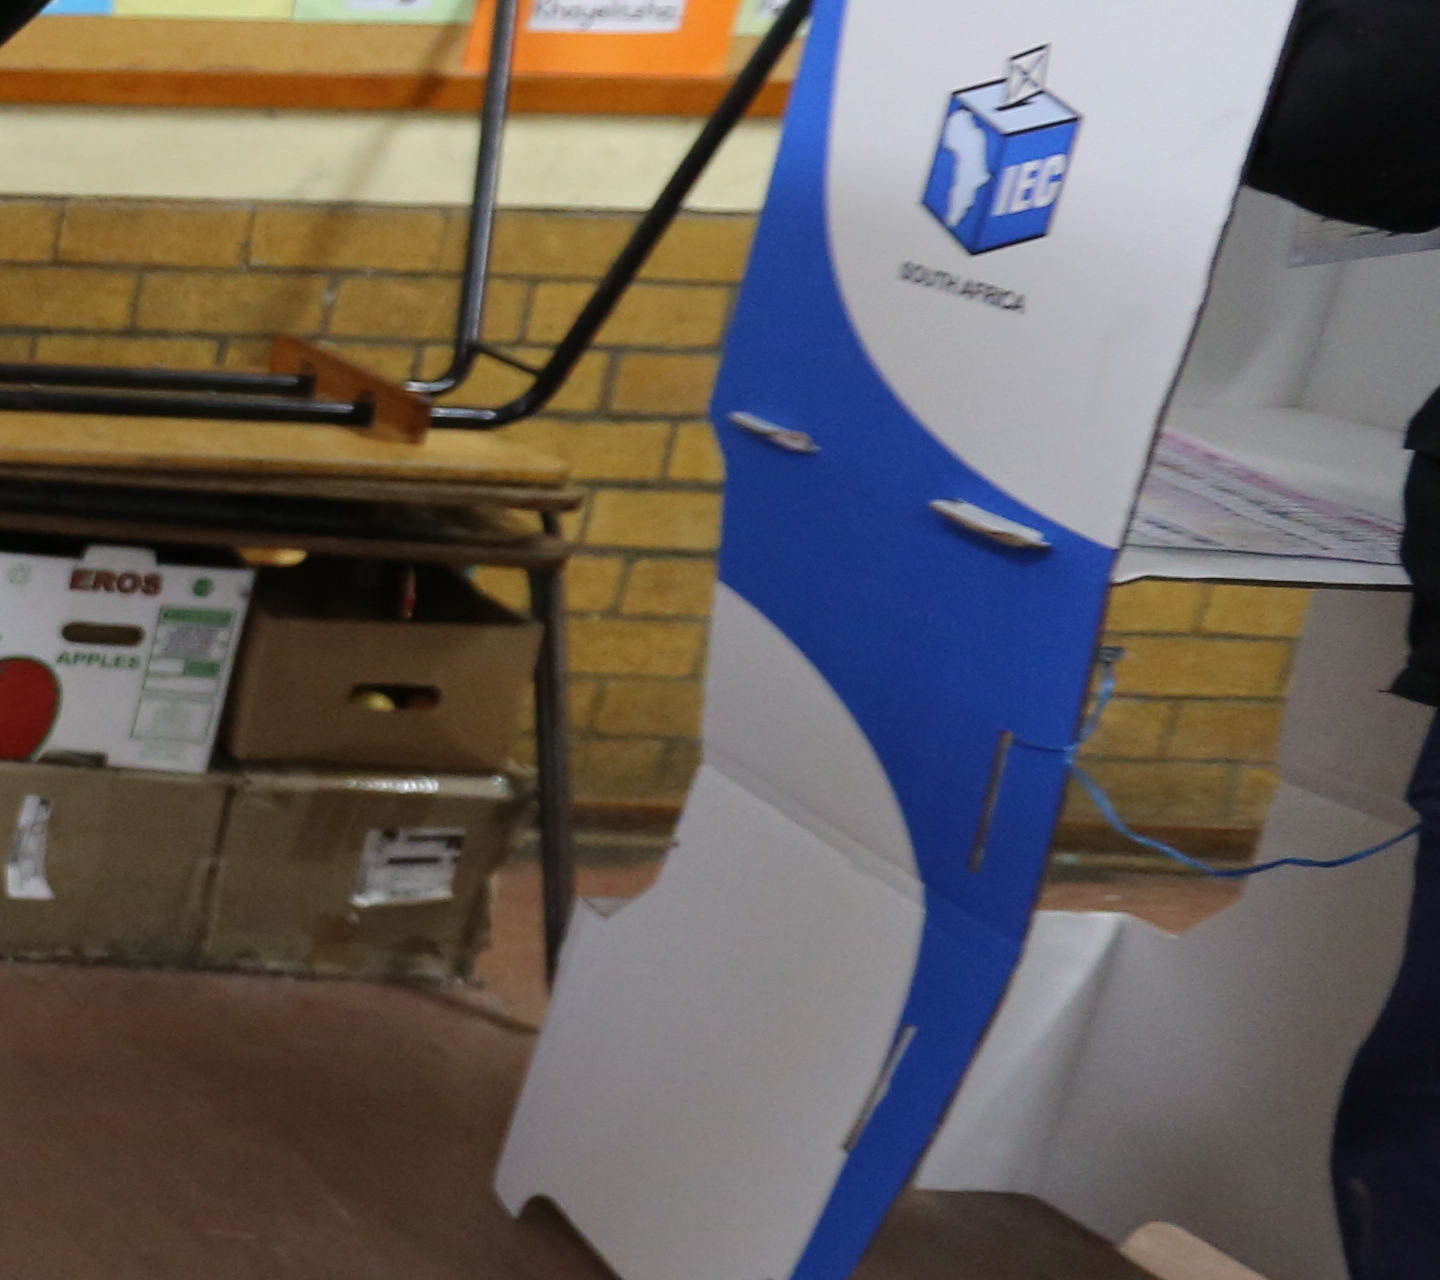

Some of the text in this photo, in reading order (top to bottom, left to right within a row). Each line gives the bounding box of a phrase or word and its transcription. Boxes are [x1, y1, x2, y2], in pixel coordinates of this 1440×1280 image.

[992, 153, 1068, 217] IEC
[899, 260, 1025, 314] SOUTH AFRICA
[70, 568, 163, 596] EROS
[57, 651, 140, 669] APPLES
